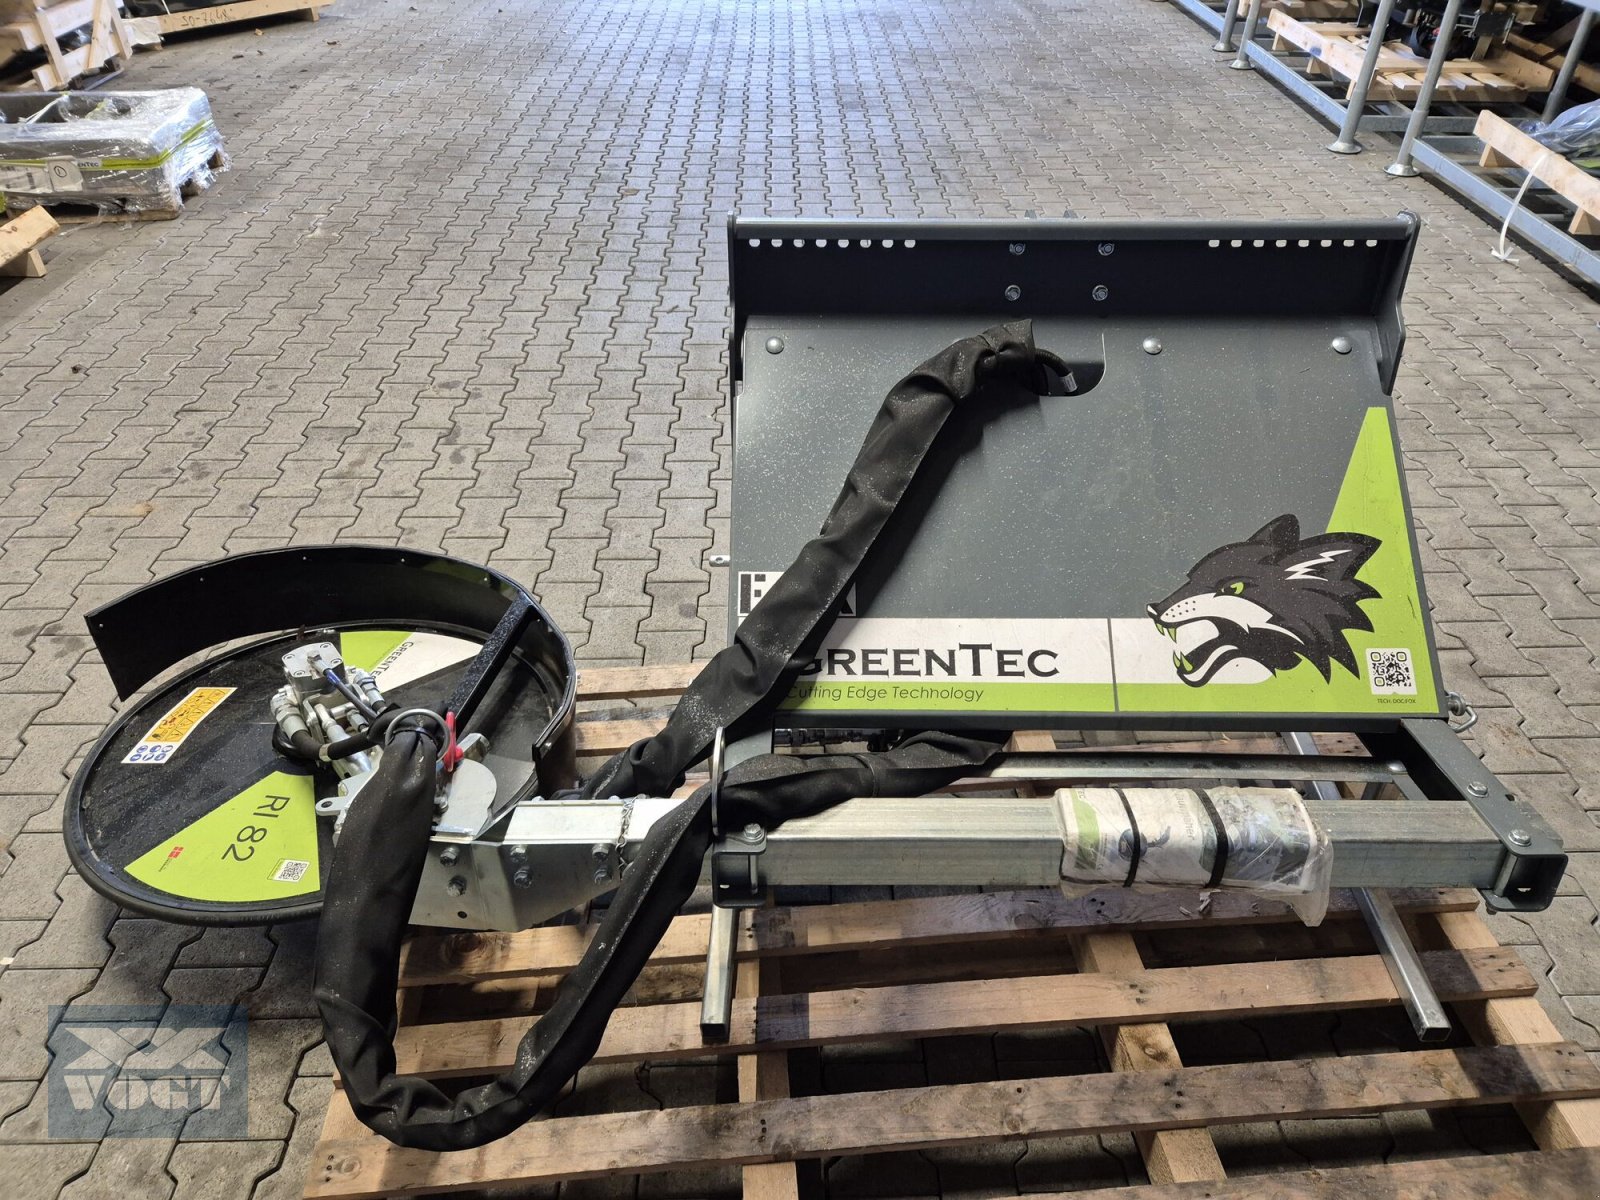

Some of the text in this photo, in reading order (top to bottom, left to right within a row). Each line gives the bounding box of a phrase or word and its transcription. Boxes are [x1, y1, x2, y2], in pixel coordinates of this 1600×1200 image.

[787, 685, 985, 702] Cutting Edge Technology
[220, 794, 291, 862] RI 82
